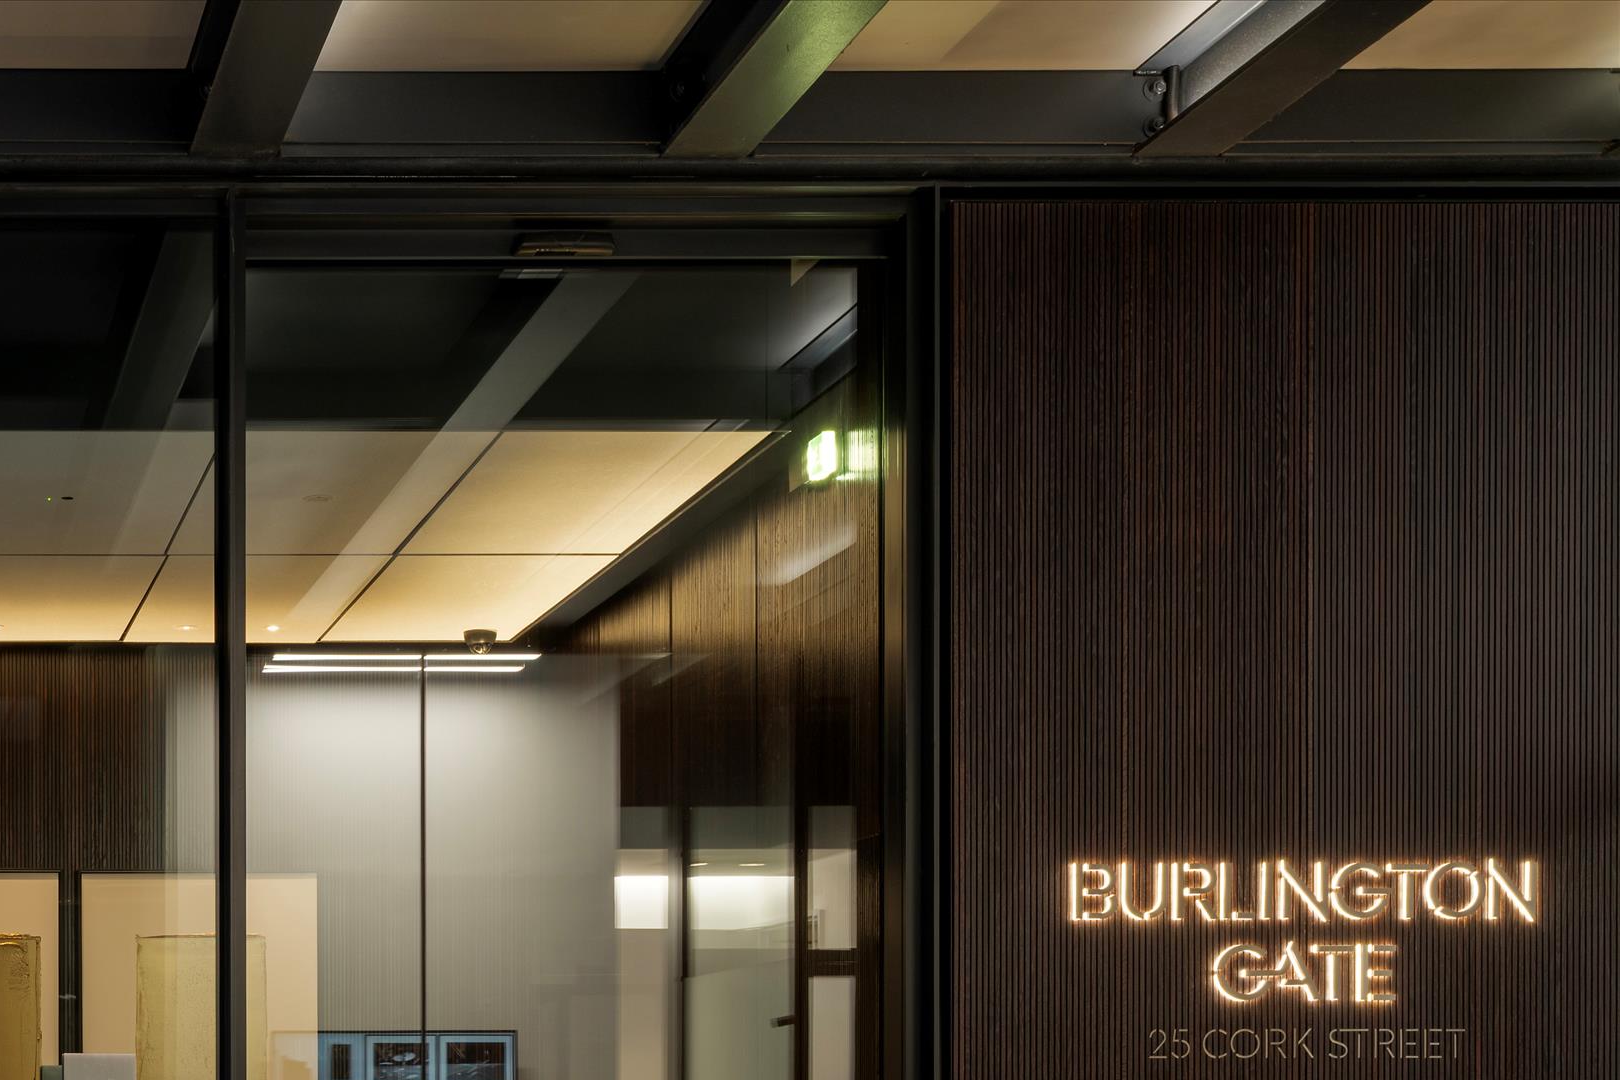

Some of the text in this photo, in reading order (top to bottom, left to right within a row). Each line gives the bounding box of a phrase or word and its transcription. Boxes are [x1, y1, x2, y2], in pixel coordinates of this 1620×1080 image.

[1070, 859, 1538, 922] BURLINGTON
[1214, 941, 1397, 1001] GATE
[1148, 1028, 1466, 1059] 25 CORK STREET
